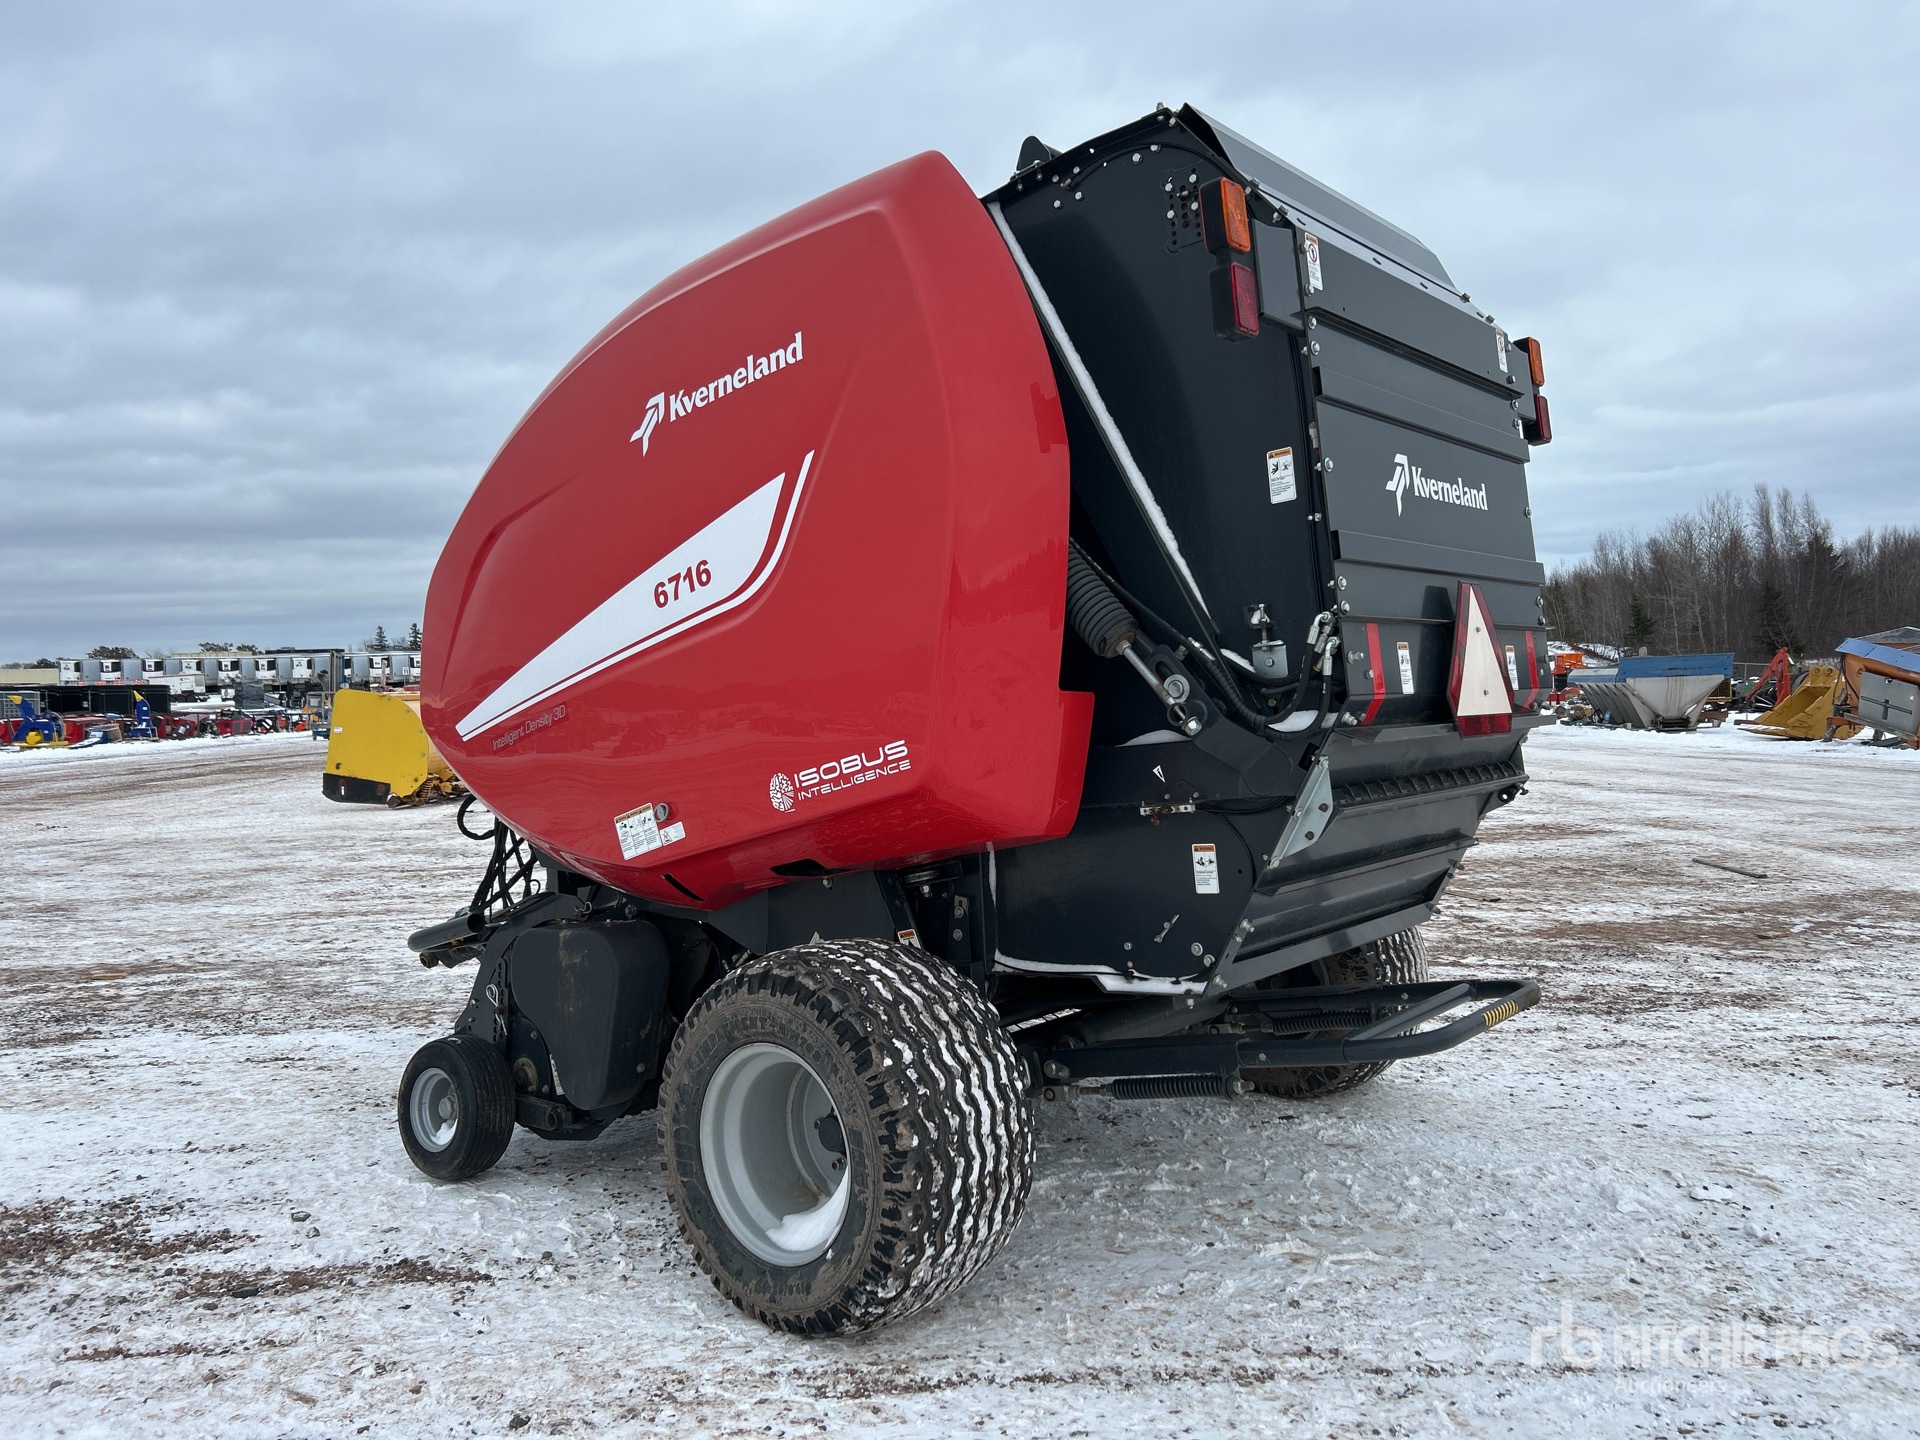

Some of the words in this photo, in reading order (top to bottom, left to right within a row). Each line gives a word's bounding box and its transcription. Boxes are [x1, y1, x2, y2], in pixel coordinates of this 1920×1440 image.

[669, 331, 803, 422] Kverneland
[1411, 465, 1489, 511] Kverneland
[653, 559, 712, 608] 6716
[492, 725, 525, 751] Intelligent
[525, 713, 553, 734] Density
[553, 704, 566, 721] 3D
[793, 739, 909, 789] ISOBUS
[797, 759, 912, 801] INTELLIGENCE
